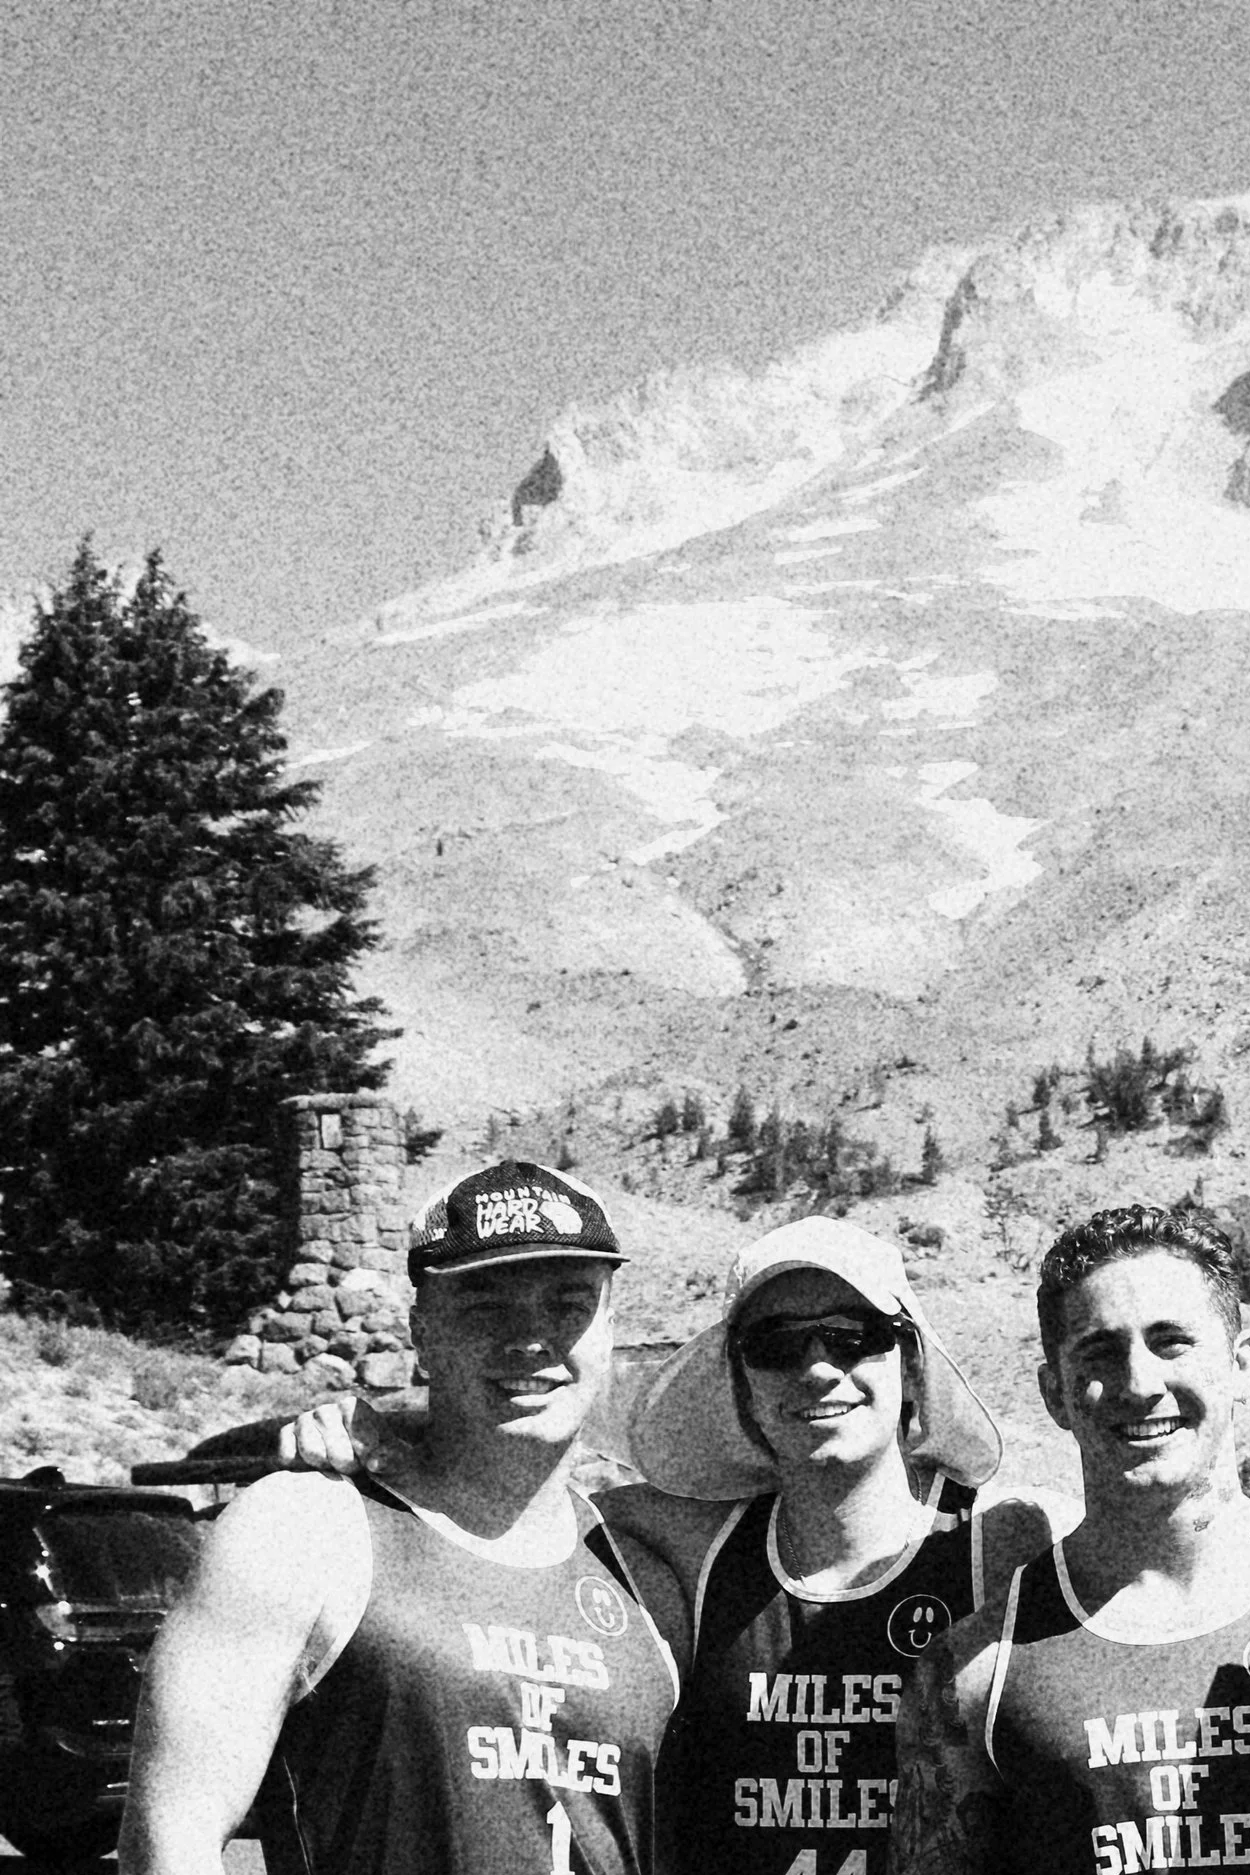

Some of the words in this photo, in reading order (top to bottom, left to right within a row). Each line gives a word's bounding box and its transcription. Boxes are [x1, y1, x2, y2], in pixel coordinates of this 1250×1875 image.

[475, 1186, 571, 1205] MOUNTAIN
[477, 1198, 539, 1221] HARD
[477, 1213, 545, 1239] WEAR
[462, 1623, 610, 1690] MILES
[520, 1681, 566, 1732] OF
[747, 1672, 902, 1723] MILES
[467, 1726, 622, 1797] SMILES
[797, 1730, 850, 1773] OF
[1149, 1764, 1209, 1811] OF
